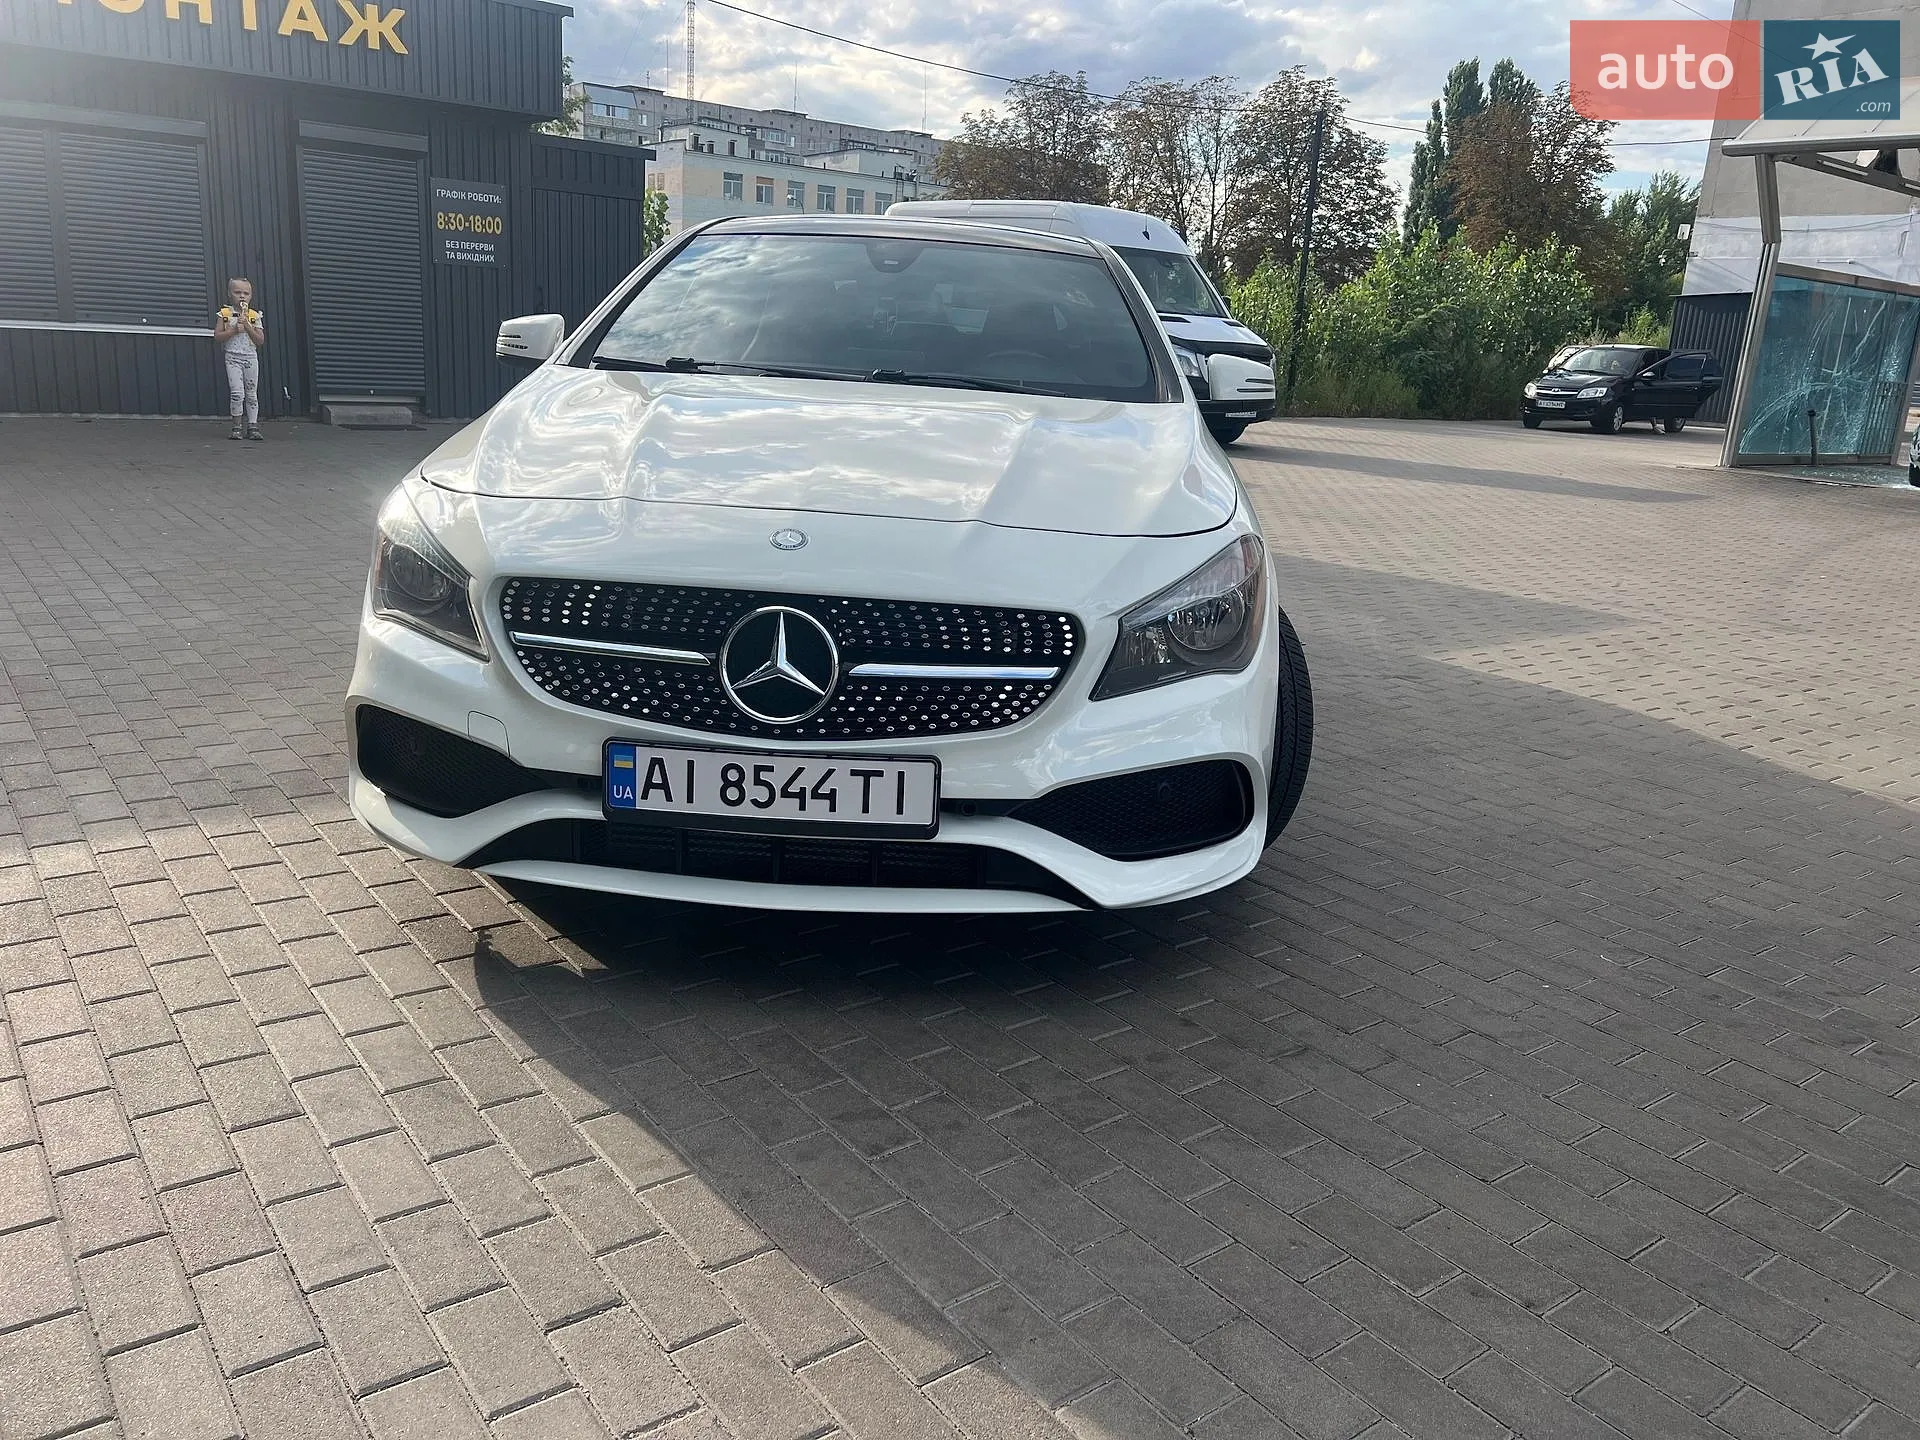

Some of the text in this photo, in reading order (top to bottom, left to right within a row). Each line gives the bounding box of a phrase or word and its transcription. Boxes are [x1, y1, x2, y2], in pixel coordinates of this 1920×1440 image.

[436, 189, 502, 204] ГРАФІК РОБОТИ:
[437, 211, 502, 235] 8:30-18:00
[445, 240, 494, 252] БЕЗ ПЕРЕРВИ
[445, 251, 495, 263] ТА ВИХІДНИХ
[640, 756, 695, 804] AI
[613, 784, 634, 800] UA
